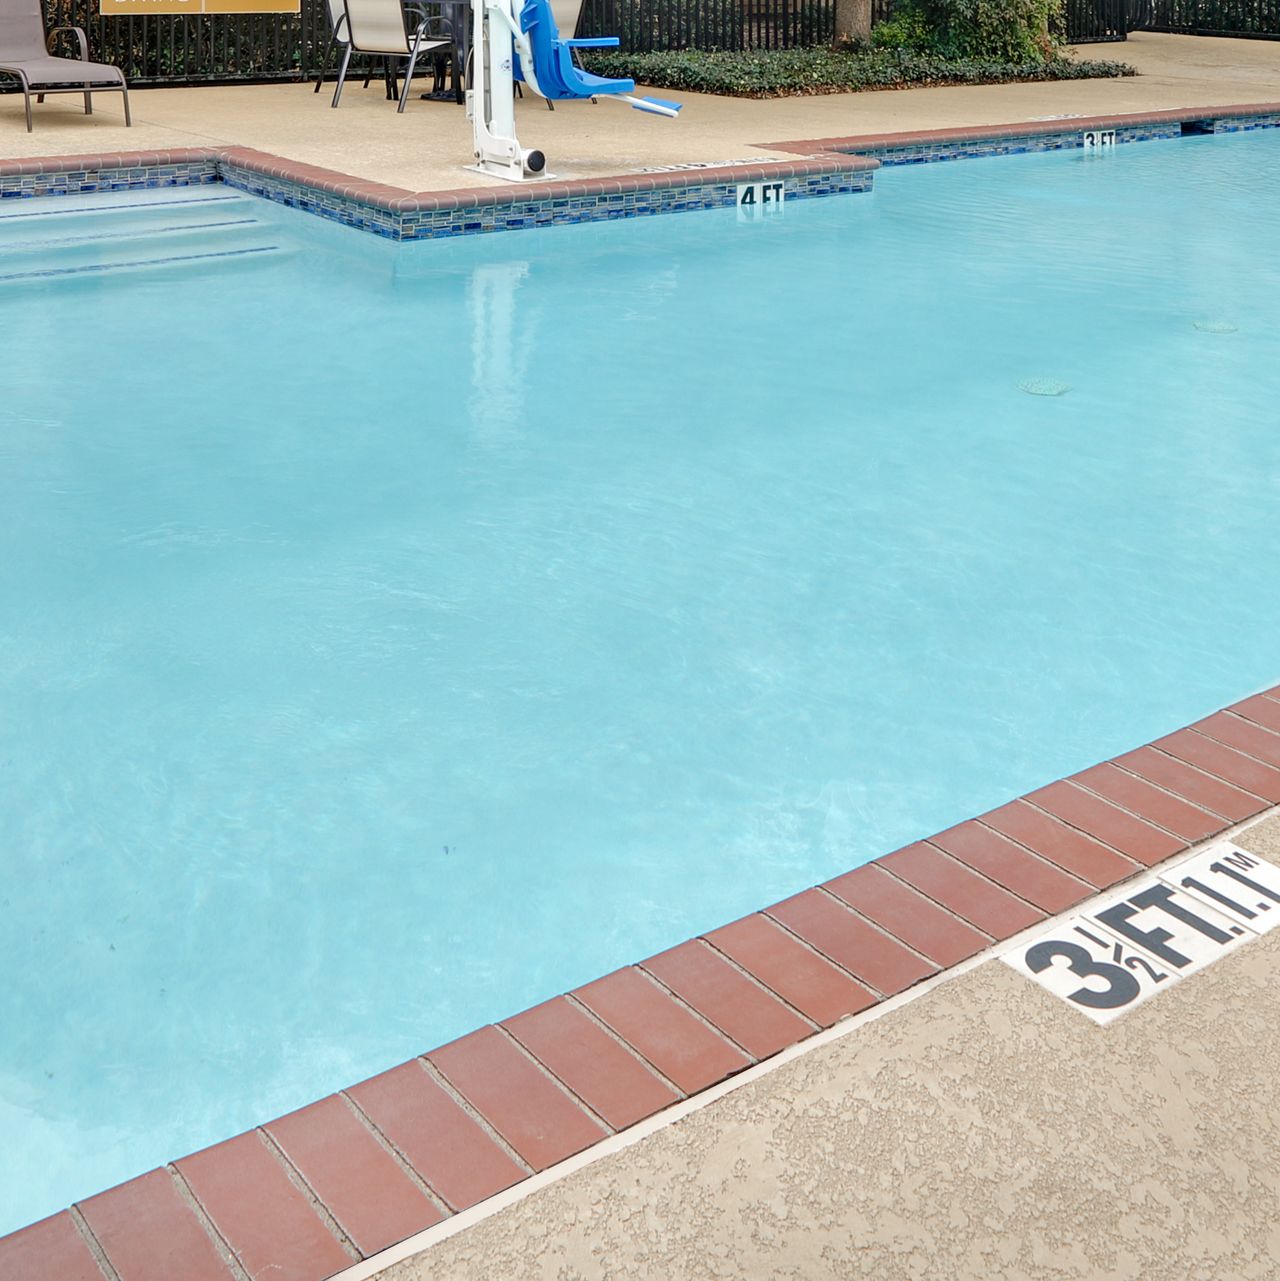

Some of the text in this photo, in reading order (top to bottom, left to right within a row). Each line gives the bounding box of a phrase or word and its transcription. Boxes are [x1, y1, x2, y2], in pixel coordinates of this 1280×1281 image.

[1101, 131, 1115, 146] FT
[741, 183, 783, 205] 4 FT
